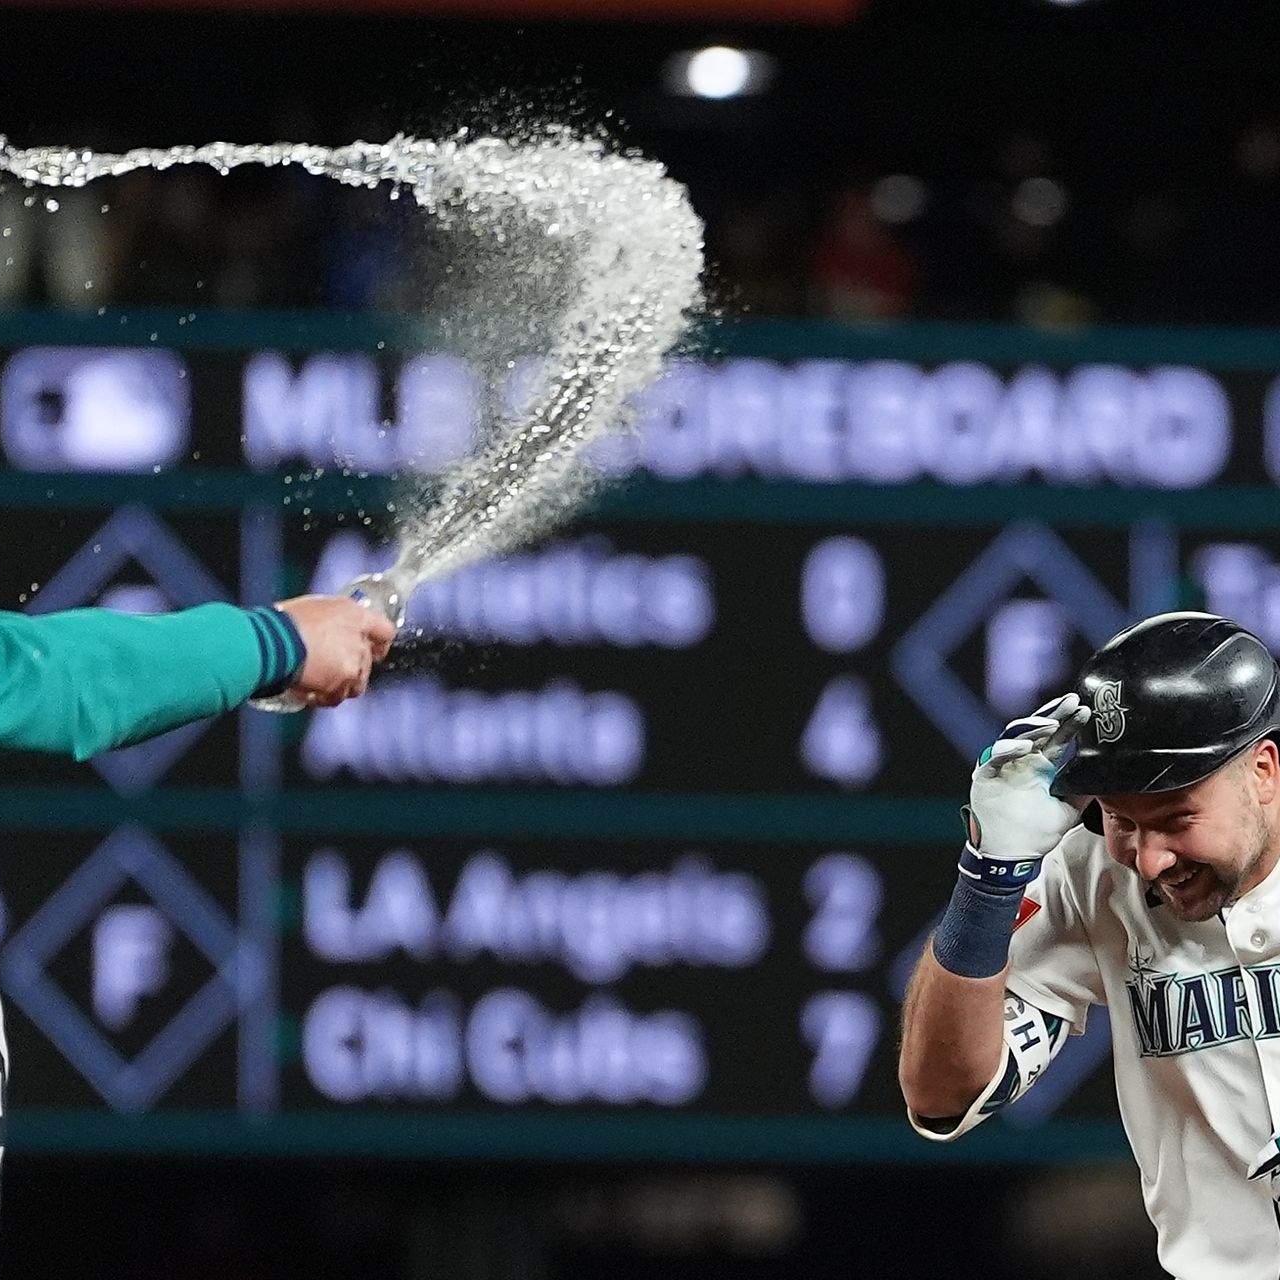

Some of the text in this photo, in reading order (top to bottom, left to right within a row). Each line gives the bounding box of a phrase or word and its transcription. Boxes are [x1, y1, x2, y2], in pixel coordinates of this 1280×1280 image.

[240, 350, 1232, 488] MLB OREBOARD
[306, 857, 876, 980] LA Angels 2
[989, 865, 1008, 876] 29
[90, 905, 172, 1030] F
[305, 990, 874, 1101] Chi Cubs 7
